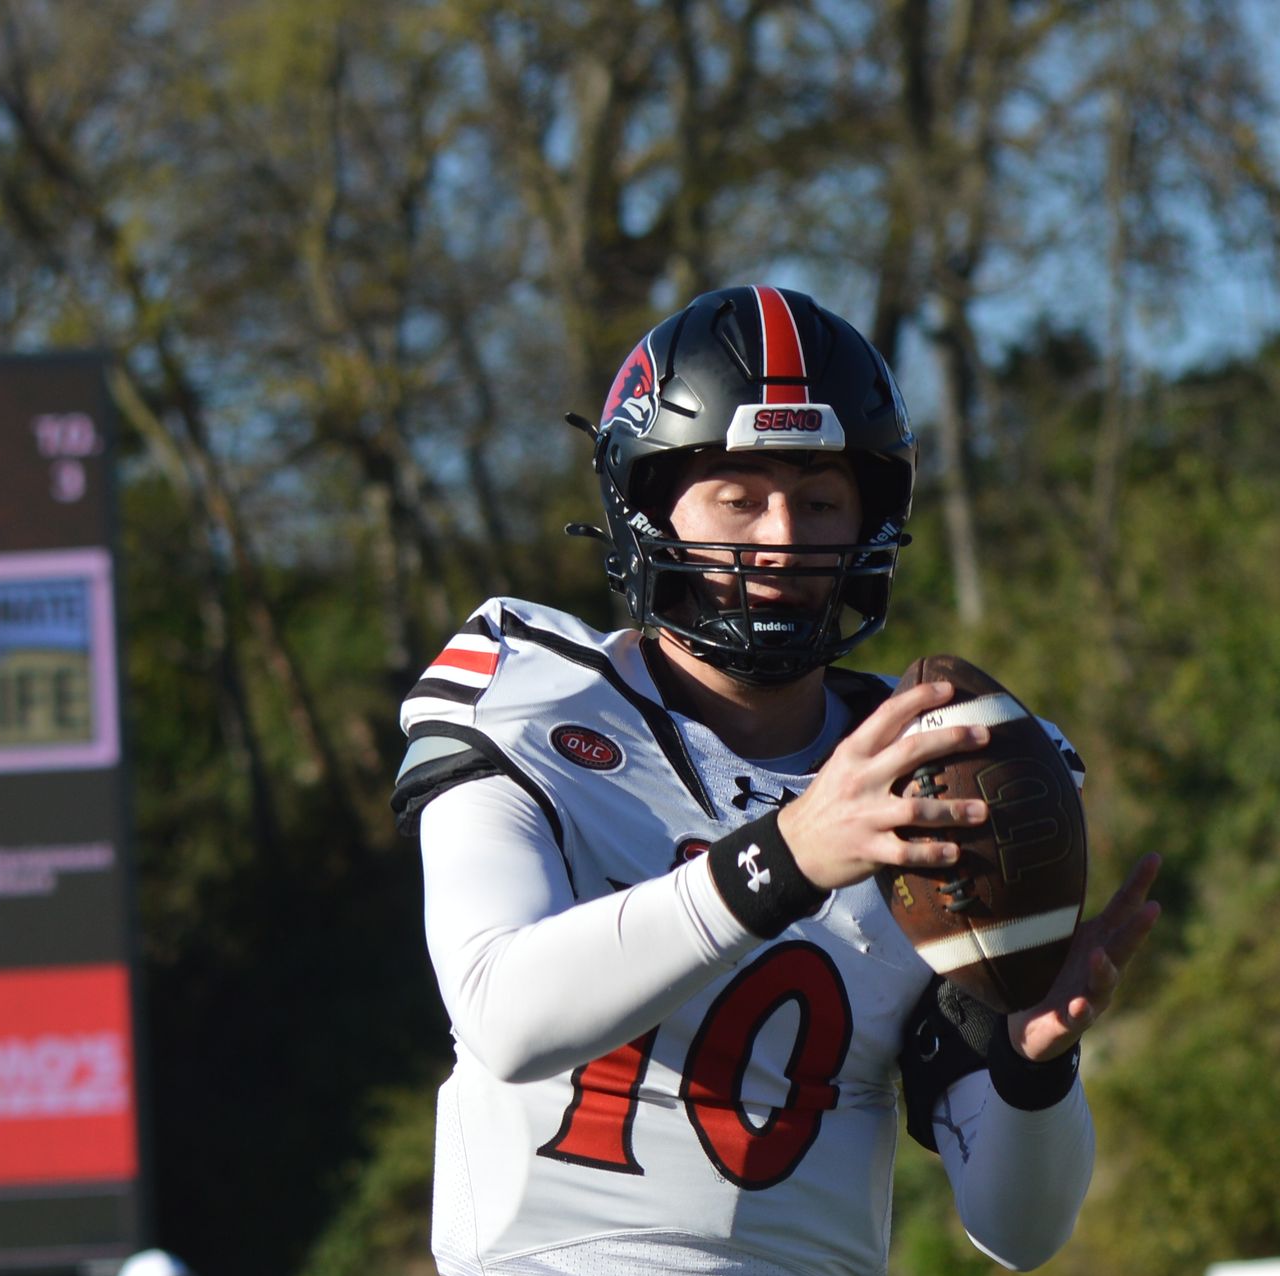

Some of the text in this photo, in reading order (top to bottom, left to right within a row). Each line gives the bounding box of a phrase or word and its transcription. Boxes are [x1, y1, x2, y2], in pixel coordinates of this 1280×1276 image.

[754, 409, 822, 431] SEMO
[753, 622, 795, 631] Riddell
[925, 715, 945, 729] MJ
[567, 737, 605, 758] OVC
